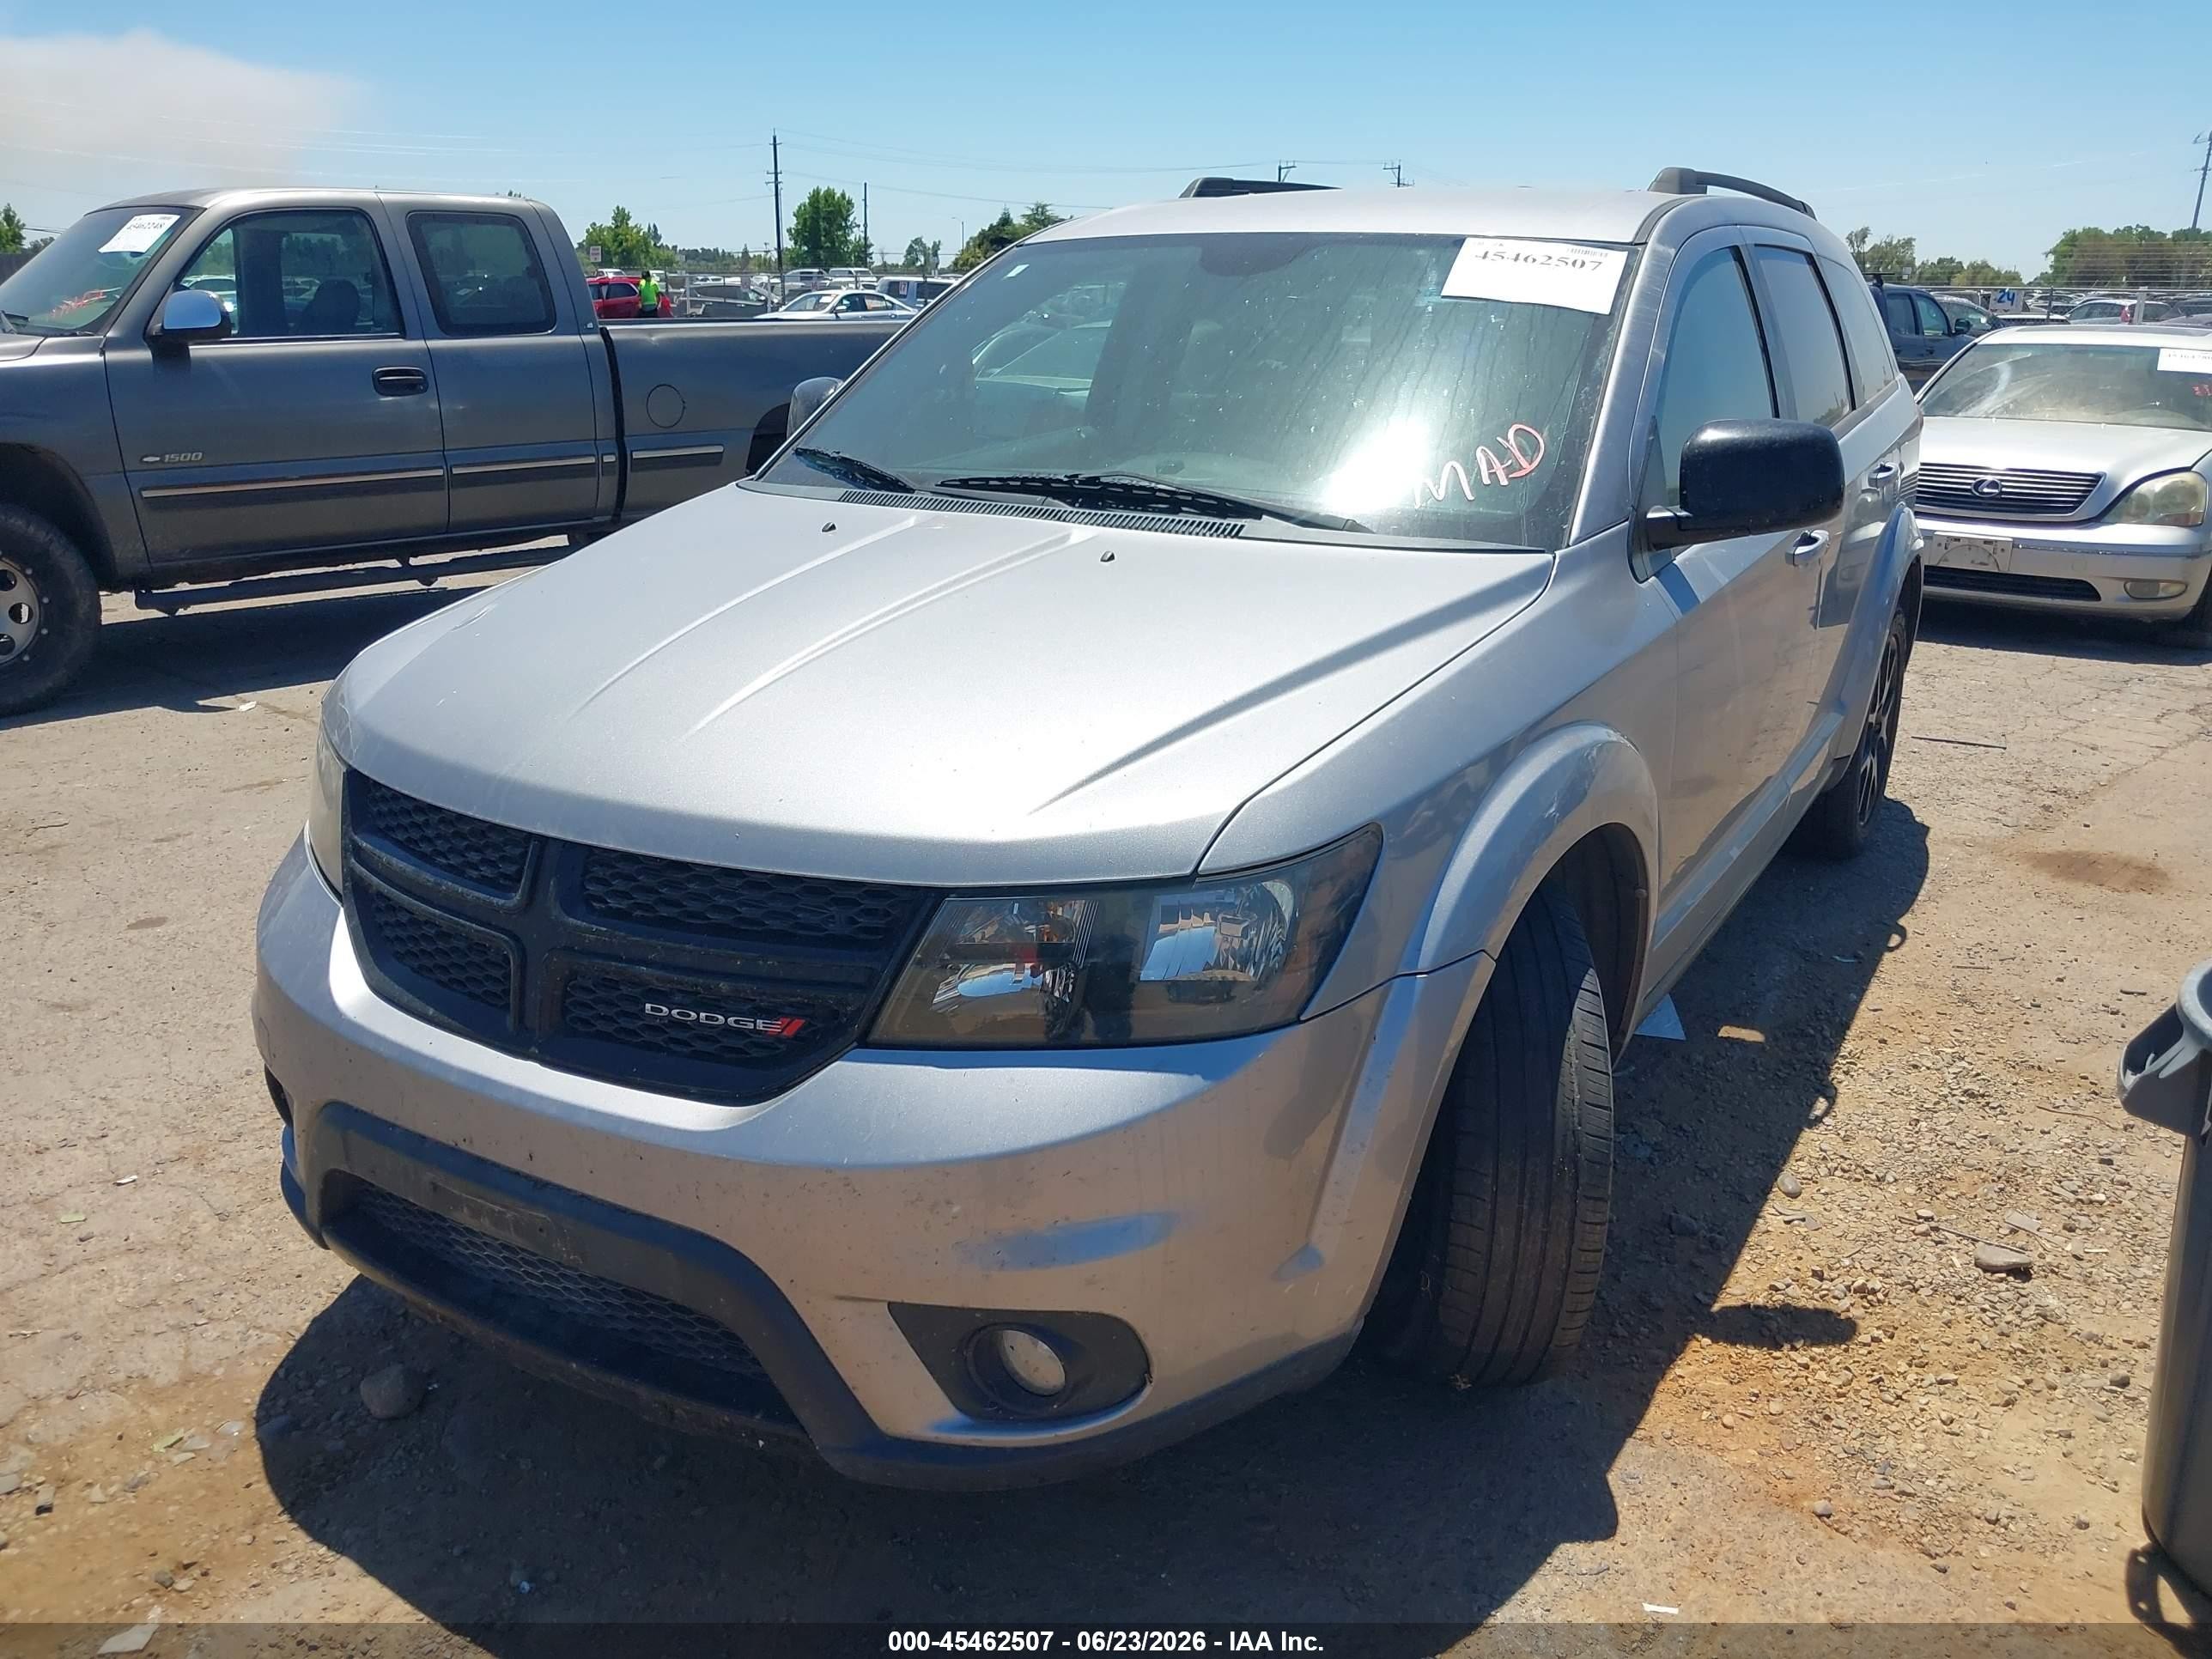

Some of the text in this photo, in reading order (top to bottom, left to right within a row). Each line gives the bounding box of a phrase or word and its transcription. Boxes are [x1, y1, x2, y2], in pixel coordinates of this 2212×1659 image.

[1474, 250, 1603, 271] 45462507
[1997, 289, 2015, 306] 24
[164, 452, 203, 463] 1500
[1413, 423, 1545, 509] MAD
[645, 1003, 783, 1032] DODGE
